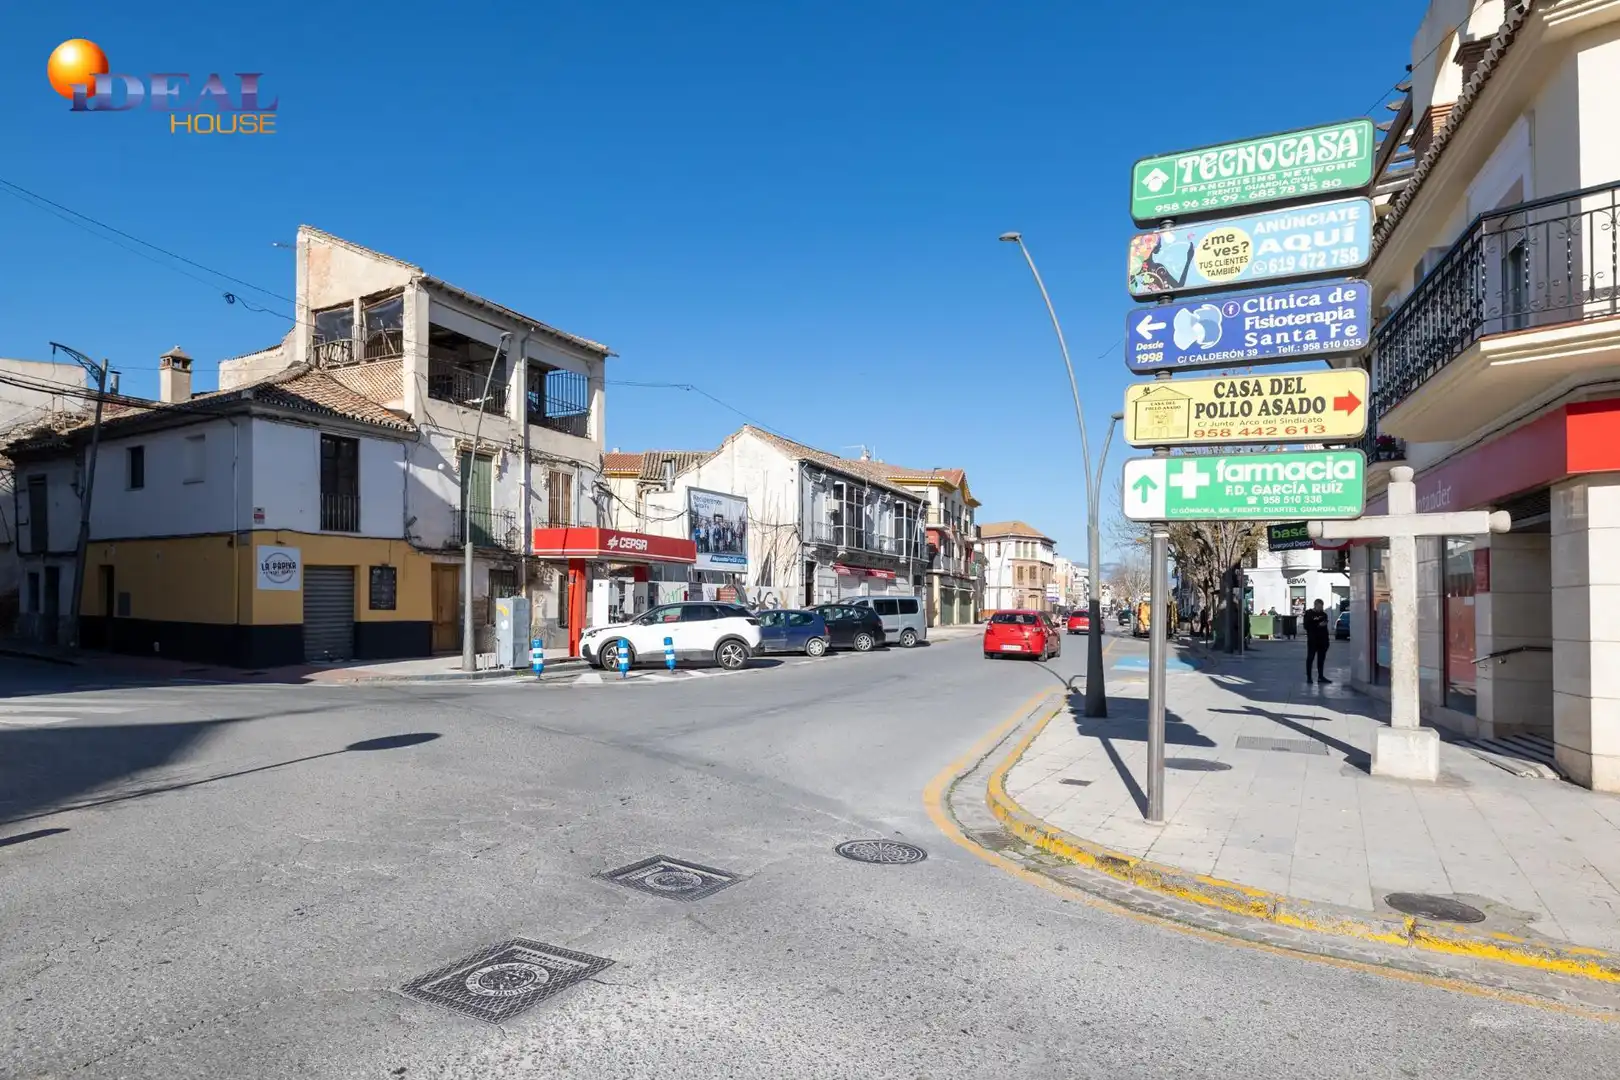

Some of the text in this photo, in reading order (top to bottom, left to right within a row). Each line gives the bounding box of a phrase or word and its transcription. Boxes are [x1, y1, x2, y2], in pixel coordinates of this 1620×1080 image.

[1178, 128, 1359, 184] TECNOCASA
[1181, 161, 1357, 194] FRANCHISING NETWORK
[1207, 174, 1315, 197] FRENTE GUARDIA CIVIL
[1154, 202, 1180, 213] 958
[1182, 199, 1199, 209] 96
[1201, 196, 1218, 206] 36
[1221, 193, 1238, 203] 99
[1248, 187, 1276, 199] 685
[1279, 183, 1297, 194] 78
[1299, 181, 1318, 192] 35
[1321, 177, 1342, 188] 80
[1253, 206, 1361, 235] ANÚNCIATE
[1202, 232, 1236, 251] ¿me
[1256, 218, 1356, 256] AQUÍ
[1212, 240, 1250, 258] ves?
[1199, 255, 1249, 270] TUS CLIENTES
[1206, 265, 1241, 277] TAMBIÉN
[1268, 255, 1296, 274] 619
[1299, 251, 1327, 270] 472
[1243, 286, 1357, 314] Clínica de
[1244, 305, 1356, 331] Fisioterapia
[1244, 322, 1358, 347] Santa Fe
[1136, 340, 1164, 351] Desde
[1177, 355, 1188, 364] C/
[1189, 349, 1245, 363] CALDERÓN
[1246, 348, 1258, 358] 39
[1276, 343, 1301, 354] Telf.:
[1302, 342, 1321, 351] 958
[1323, 340, 1342, 349] 510
[1342, 338, 1362, 348] 035
[1135, 351, 1164, 363] 1998
[1213, 376, 1307, 399] CASA DEL
[1194, 396, 1326, 420] POLLO ASADO
[1193, 424, 1326, 439] 958 442 613
[1197, 420, 1207, 428] C/
[1261, 418, 1277, 426] del
[1279, 416, 1323, 425] Sindicato
[1215, 456, 1356, 483] farmacia
[1251, 480, 1307, 495] GARCÍA
[1312, 480, 1343, 494] RUÍZ
[1300, 505, 1336, 513] GUARDIA
[1337, 505, 1358, 513] CIVIL
[619, 536, 648, 551] CEPSA
[1270, 541, 1295, 550] Liverpool
[261, 562, 270, 572] LA
[1286, 577, 1307, 585] BBVA
